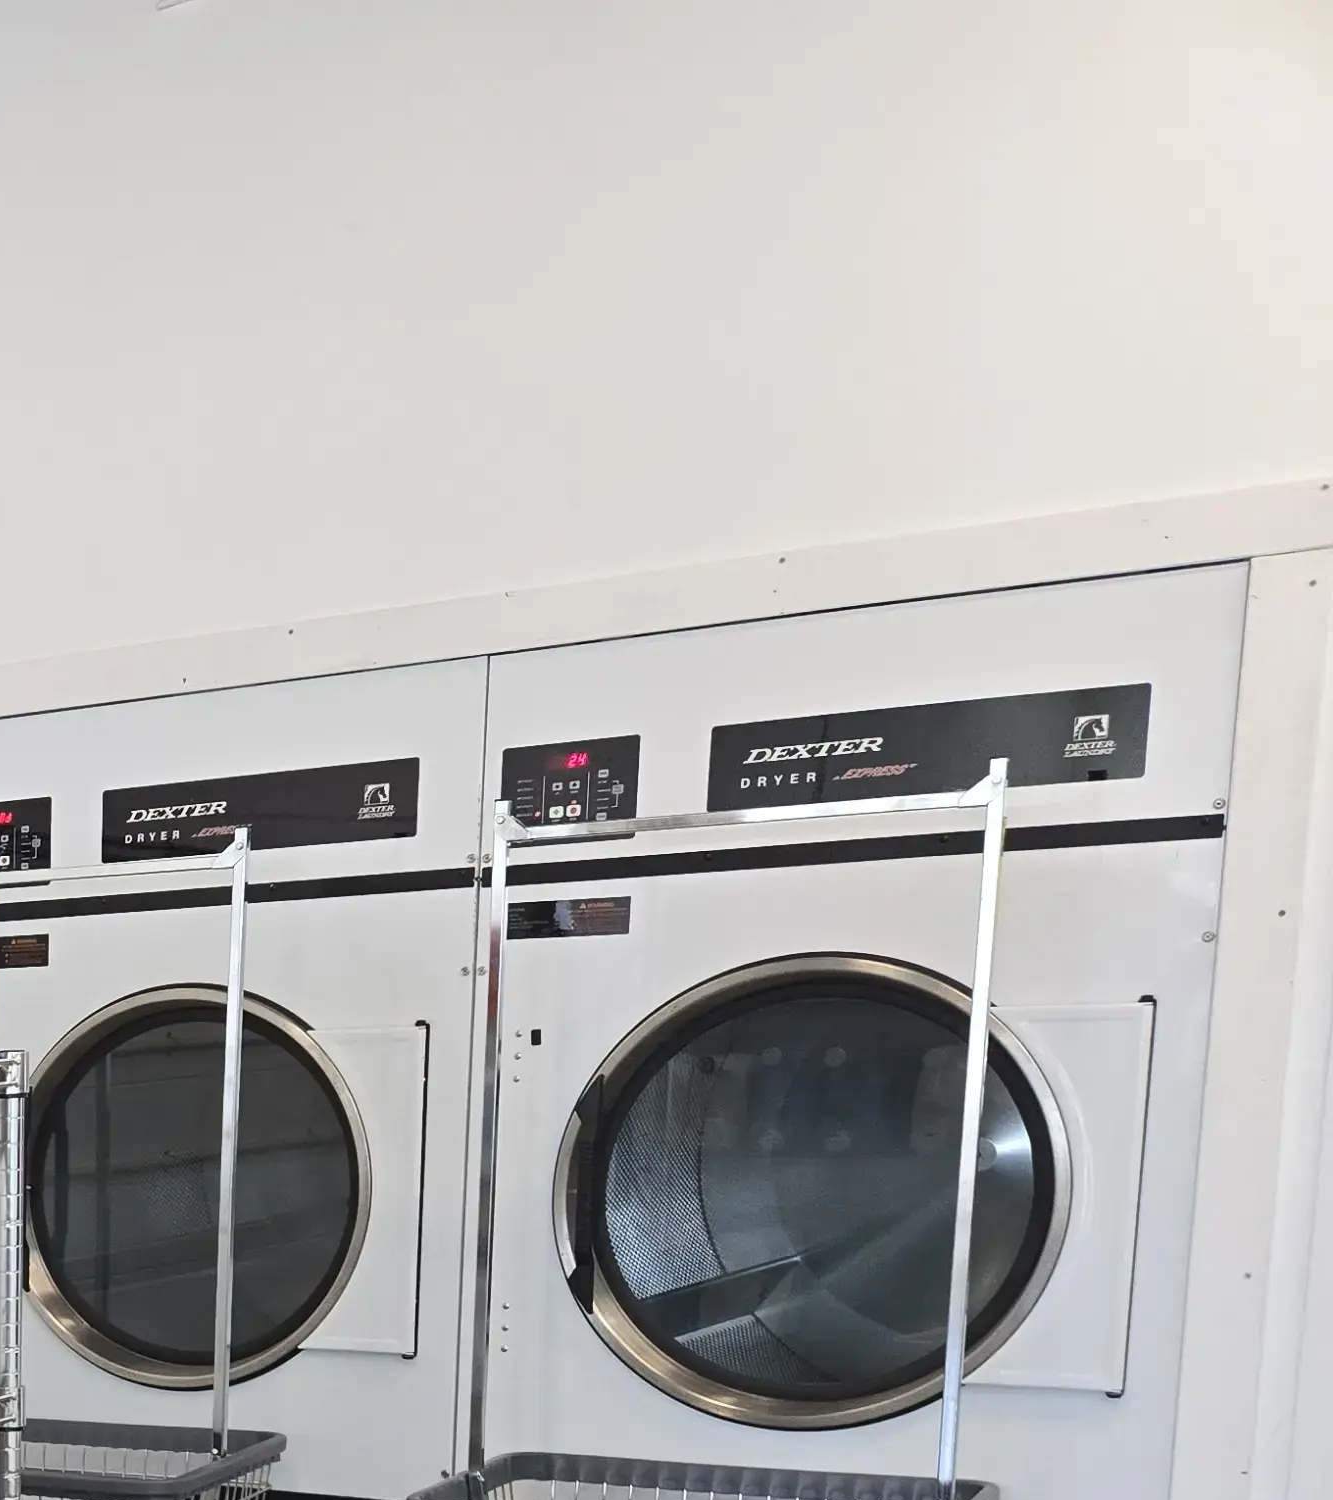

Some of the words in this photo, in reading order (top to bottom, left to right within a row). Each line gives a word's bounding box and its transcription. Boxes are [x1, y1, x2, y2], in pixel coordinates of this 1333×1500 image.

[742, 736, 884, 765] DEXTER
[1063, 747, 1117, 758] LAUNDRY
[1064, 740, 1115, 751] DEXTER
[841, 764, 910, 780] EXPRESS
[740, 772, 817, 789] DRYER
[126, 801, 227, 823] DEXTER
[357, 805, 395, 814] DEXTER
[124, 830, 181, 844] DRYER
